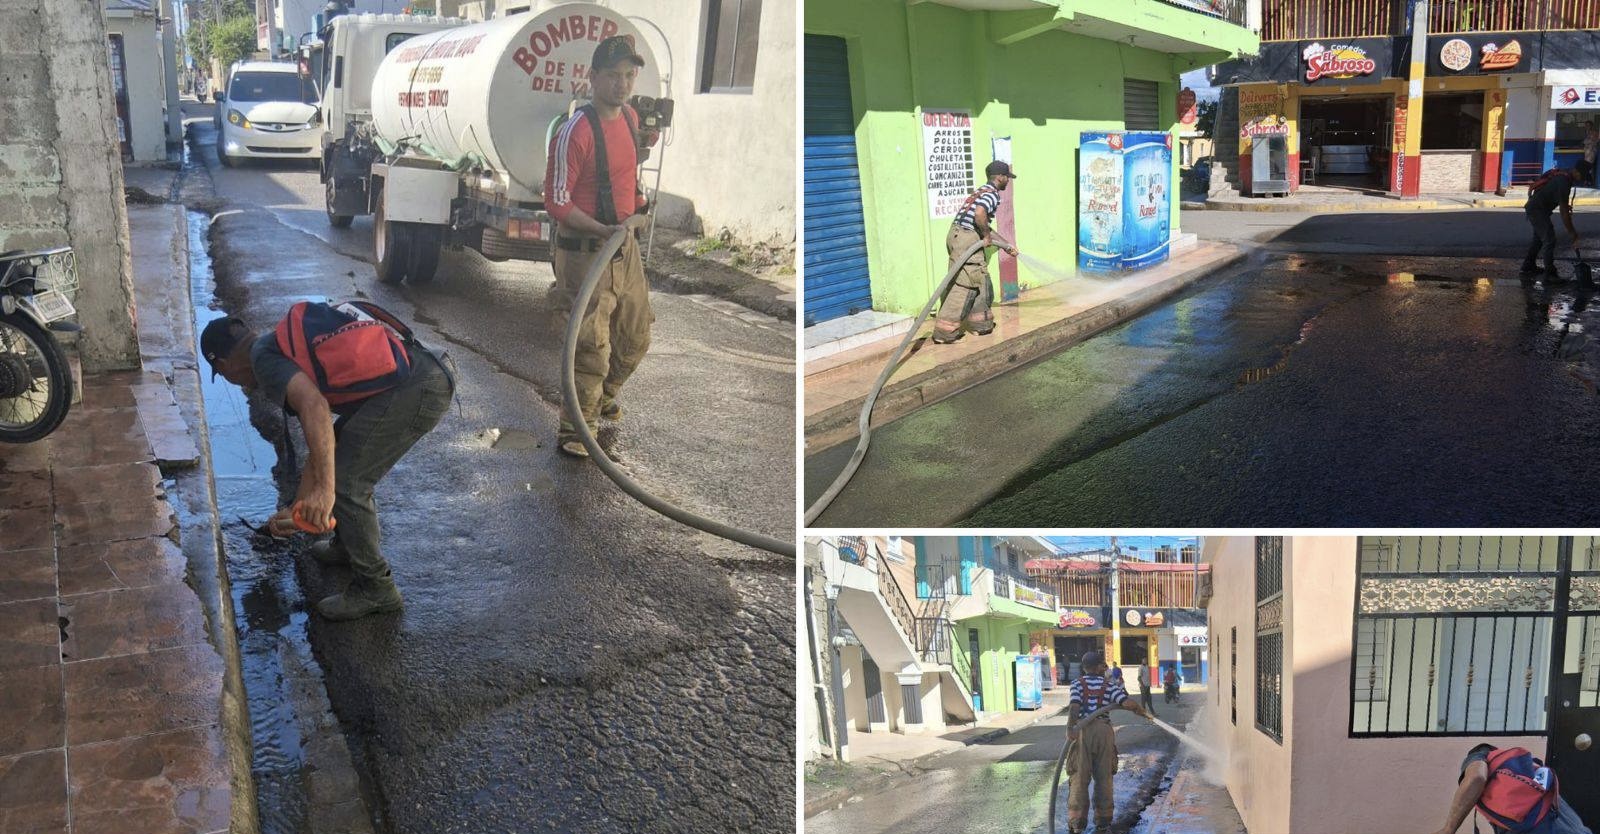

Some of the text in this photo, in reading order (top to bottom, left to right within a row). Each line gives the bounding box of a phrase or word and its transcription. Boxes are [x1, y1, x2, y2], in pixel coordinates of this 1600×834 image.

[1331, 44, 1367, 57] Comedor
[544, 61, 565, 76] DE
[1307, 55, 1374, 79] Sabroso
[532, 76, 563, 94] DEL
[923, 112, 971, 127] OFERTA
[934, 137, 962, 145] POLLO
[933, 145, 962, 153] CERDO
[929, 154, 964, 163] CHULETA
[944, 180, 965, 188] SALADA
[938, 188, 965, 196] ASUCAR
[1059, 614, 1094, 627] Sabroso
